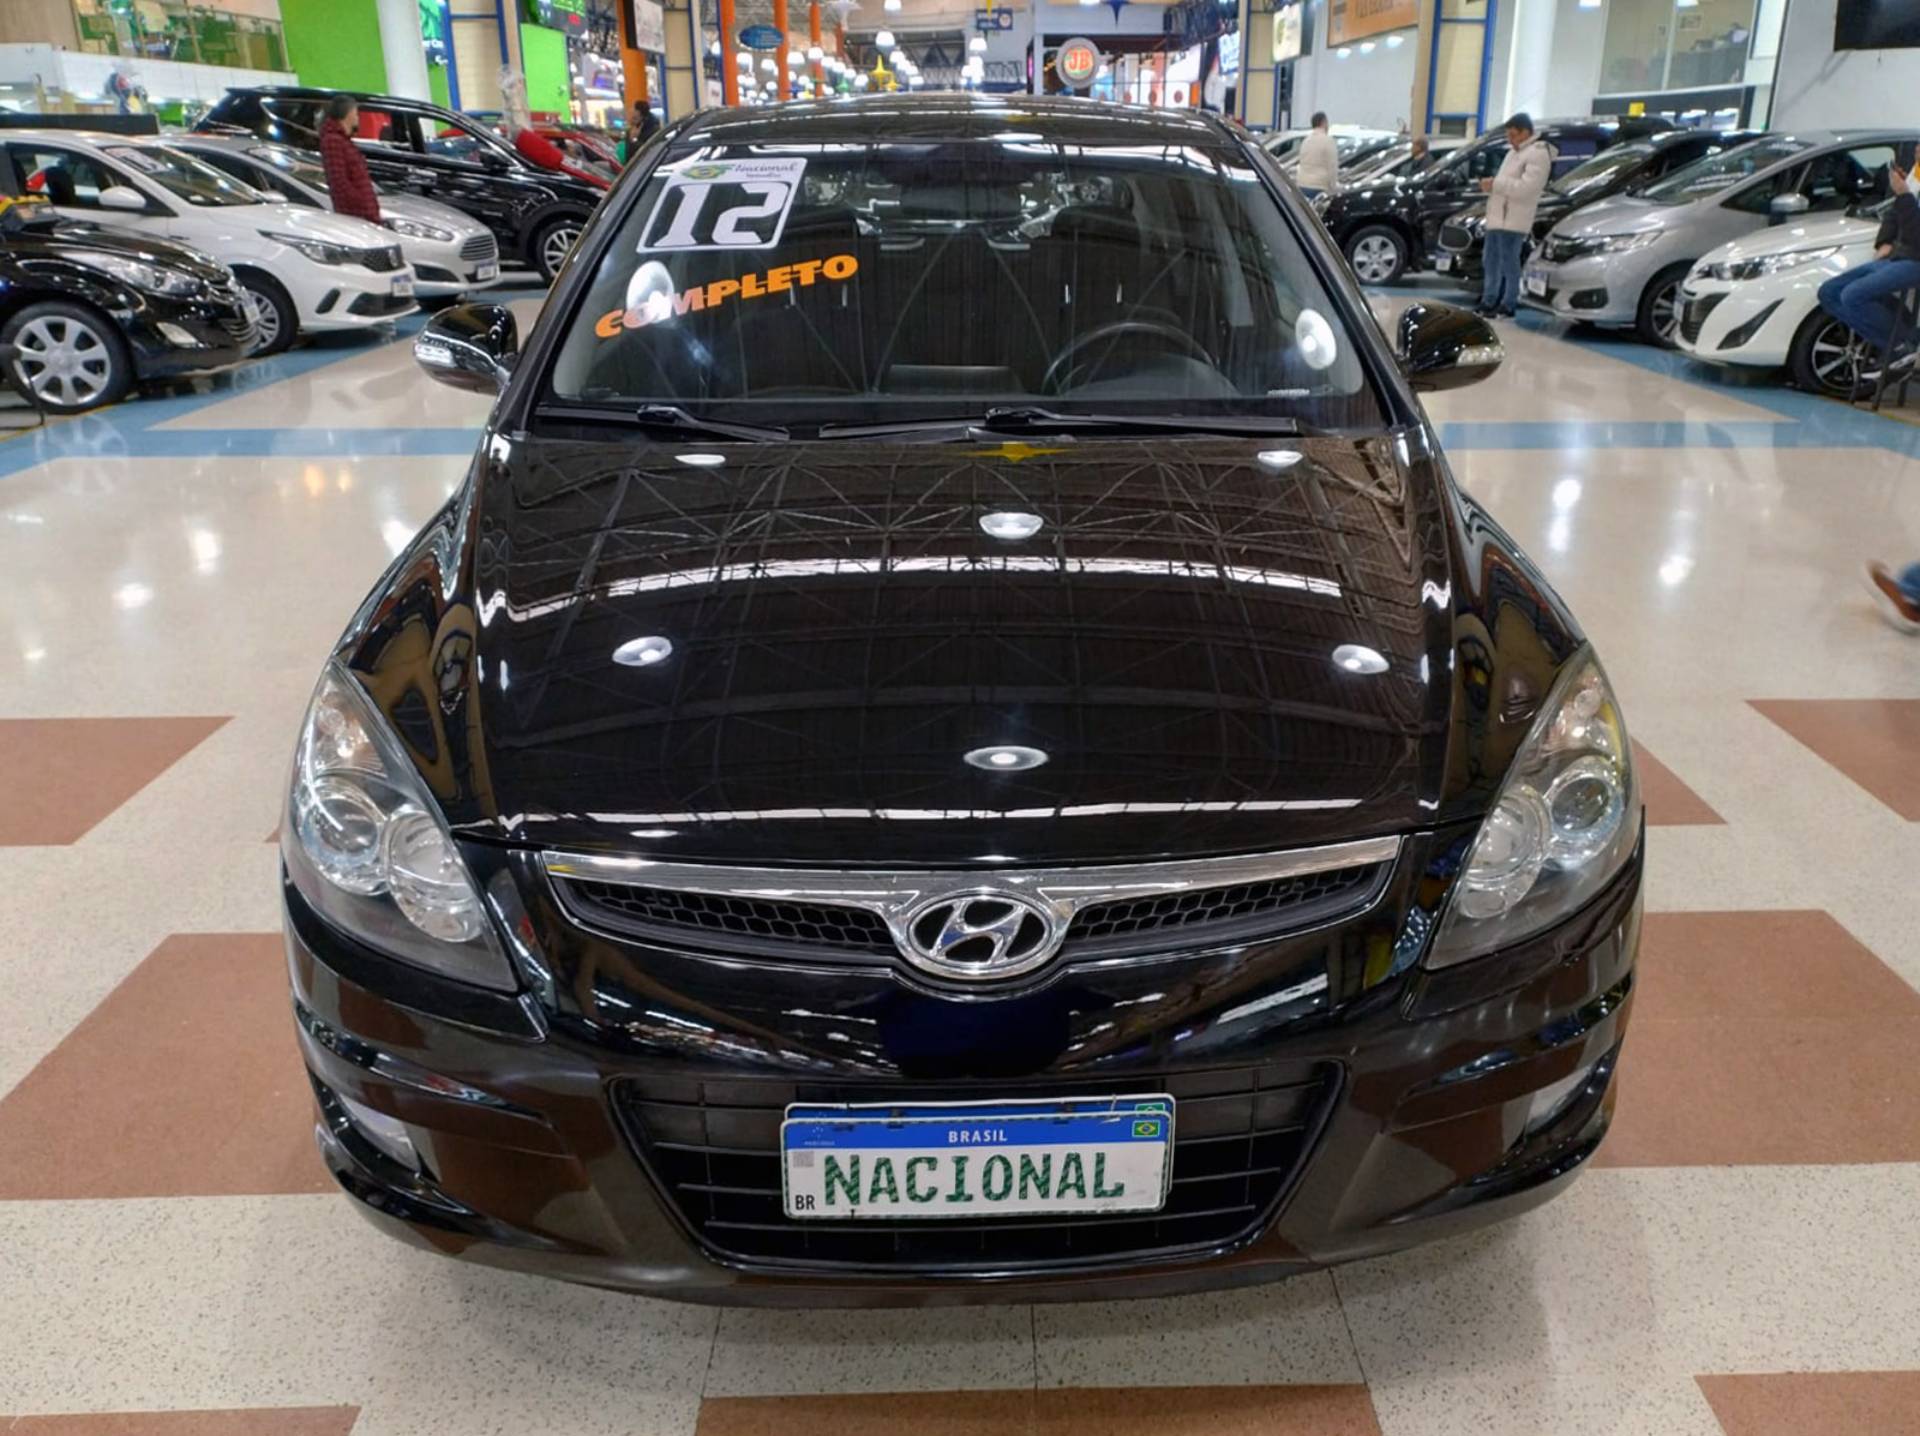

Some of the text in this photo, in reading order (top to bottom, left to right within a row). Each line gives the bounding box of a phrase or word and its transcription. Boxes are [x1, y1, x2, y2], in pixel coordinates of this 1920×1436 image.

[1068, 47, 1091, 70] JB
[653, 182, 790, 247] 12
[594, 254, 859, 338] COMPLETO
[948, 1128, 1008, 1143] BRASIL
[824, 1151, 1125, 1206] NACIONAL
[795, 1194, 816, 1211] BR
